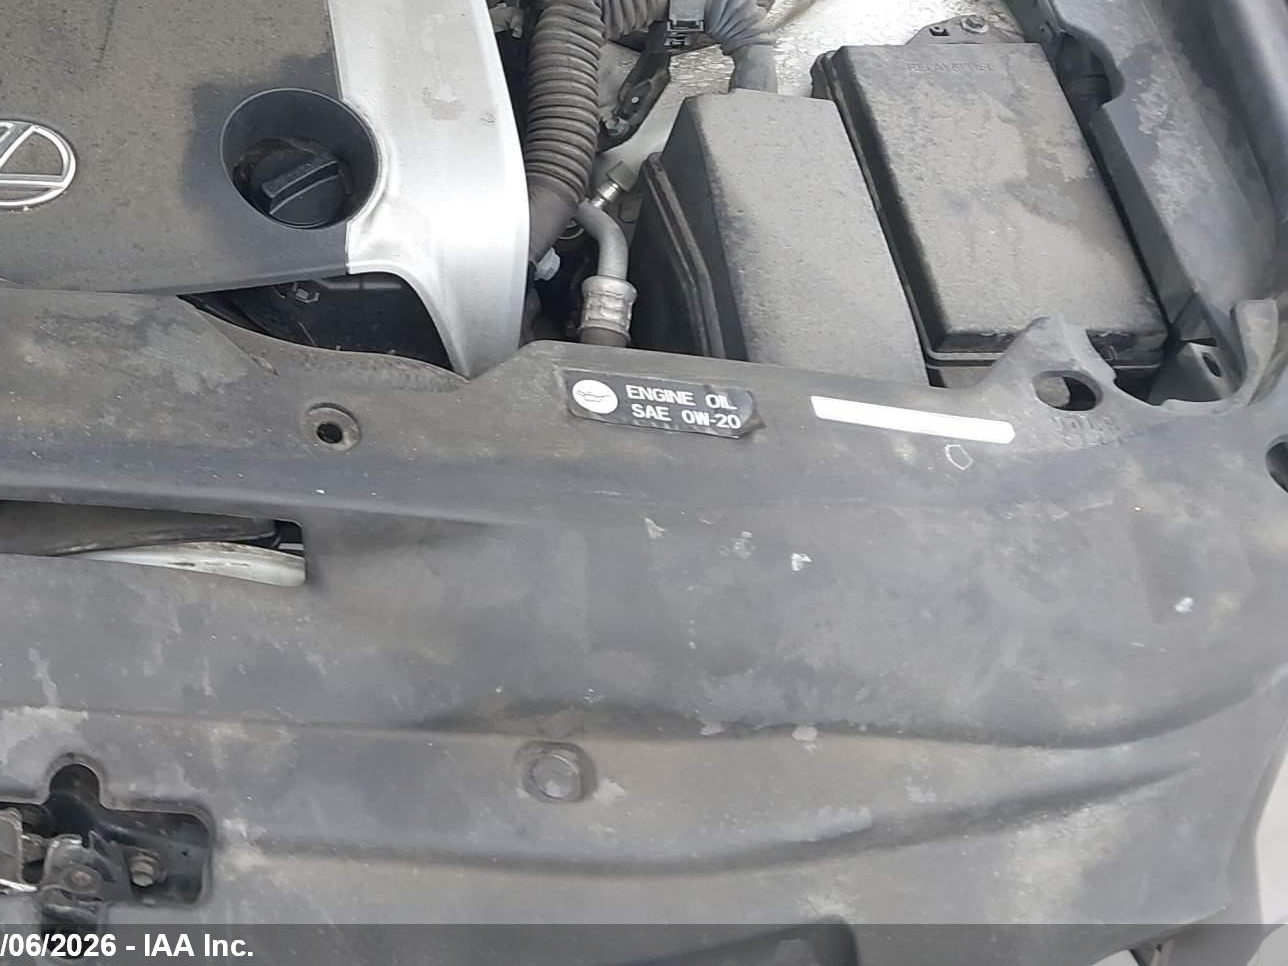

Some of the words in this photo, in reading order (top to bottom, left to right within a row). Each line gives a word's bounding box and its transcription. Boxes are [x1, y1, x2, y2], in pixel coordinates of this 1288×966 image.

[625, 384, 696, 407] ENGINE
[705, 394, 738, 410] OIL
[631, 403, 672, 421] SAE
[681, 409, 742, 429] 0W-20
